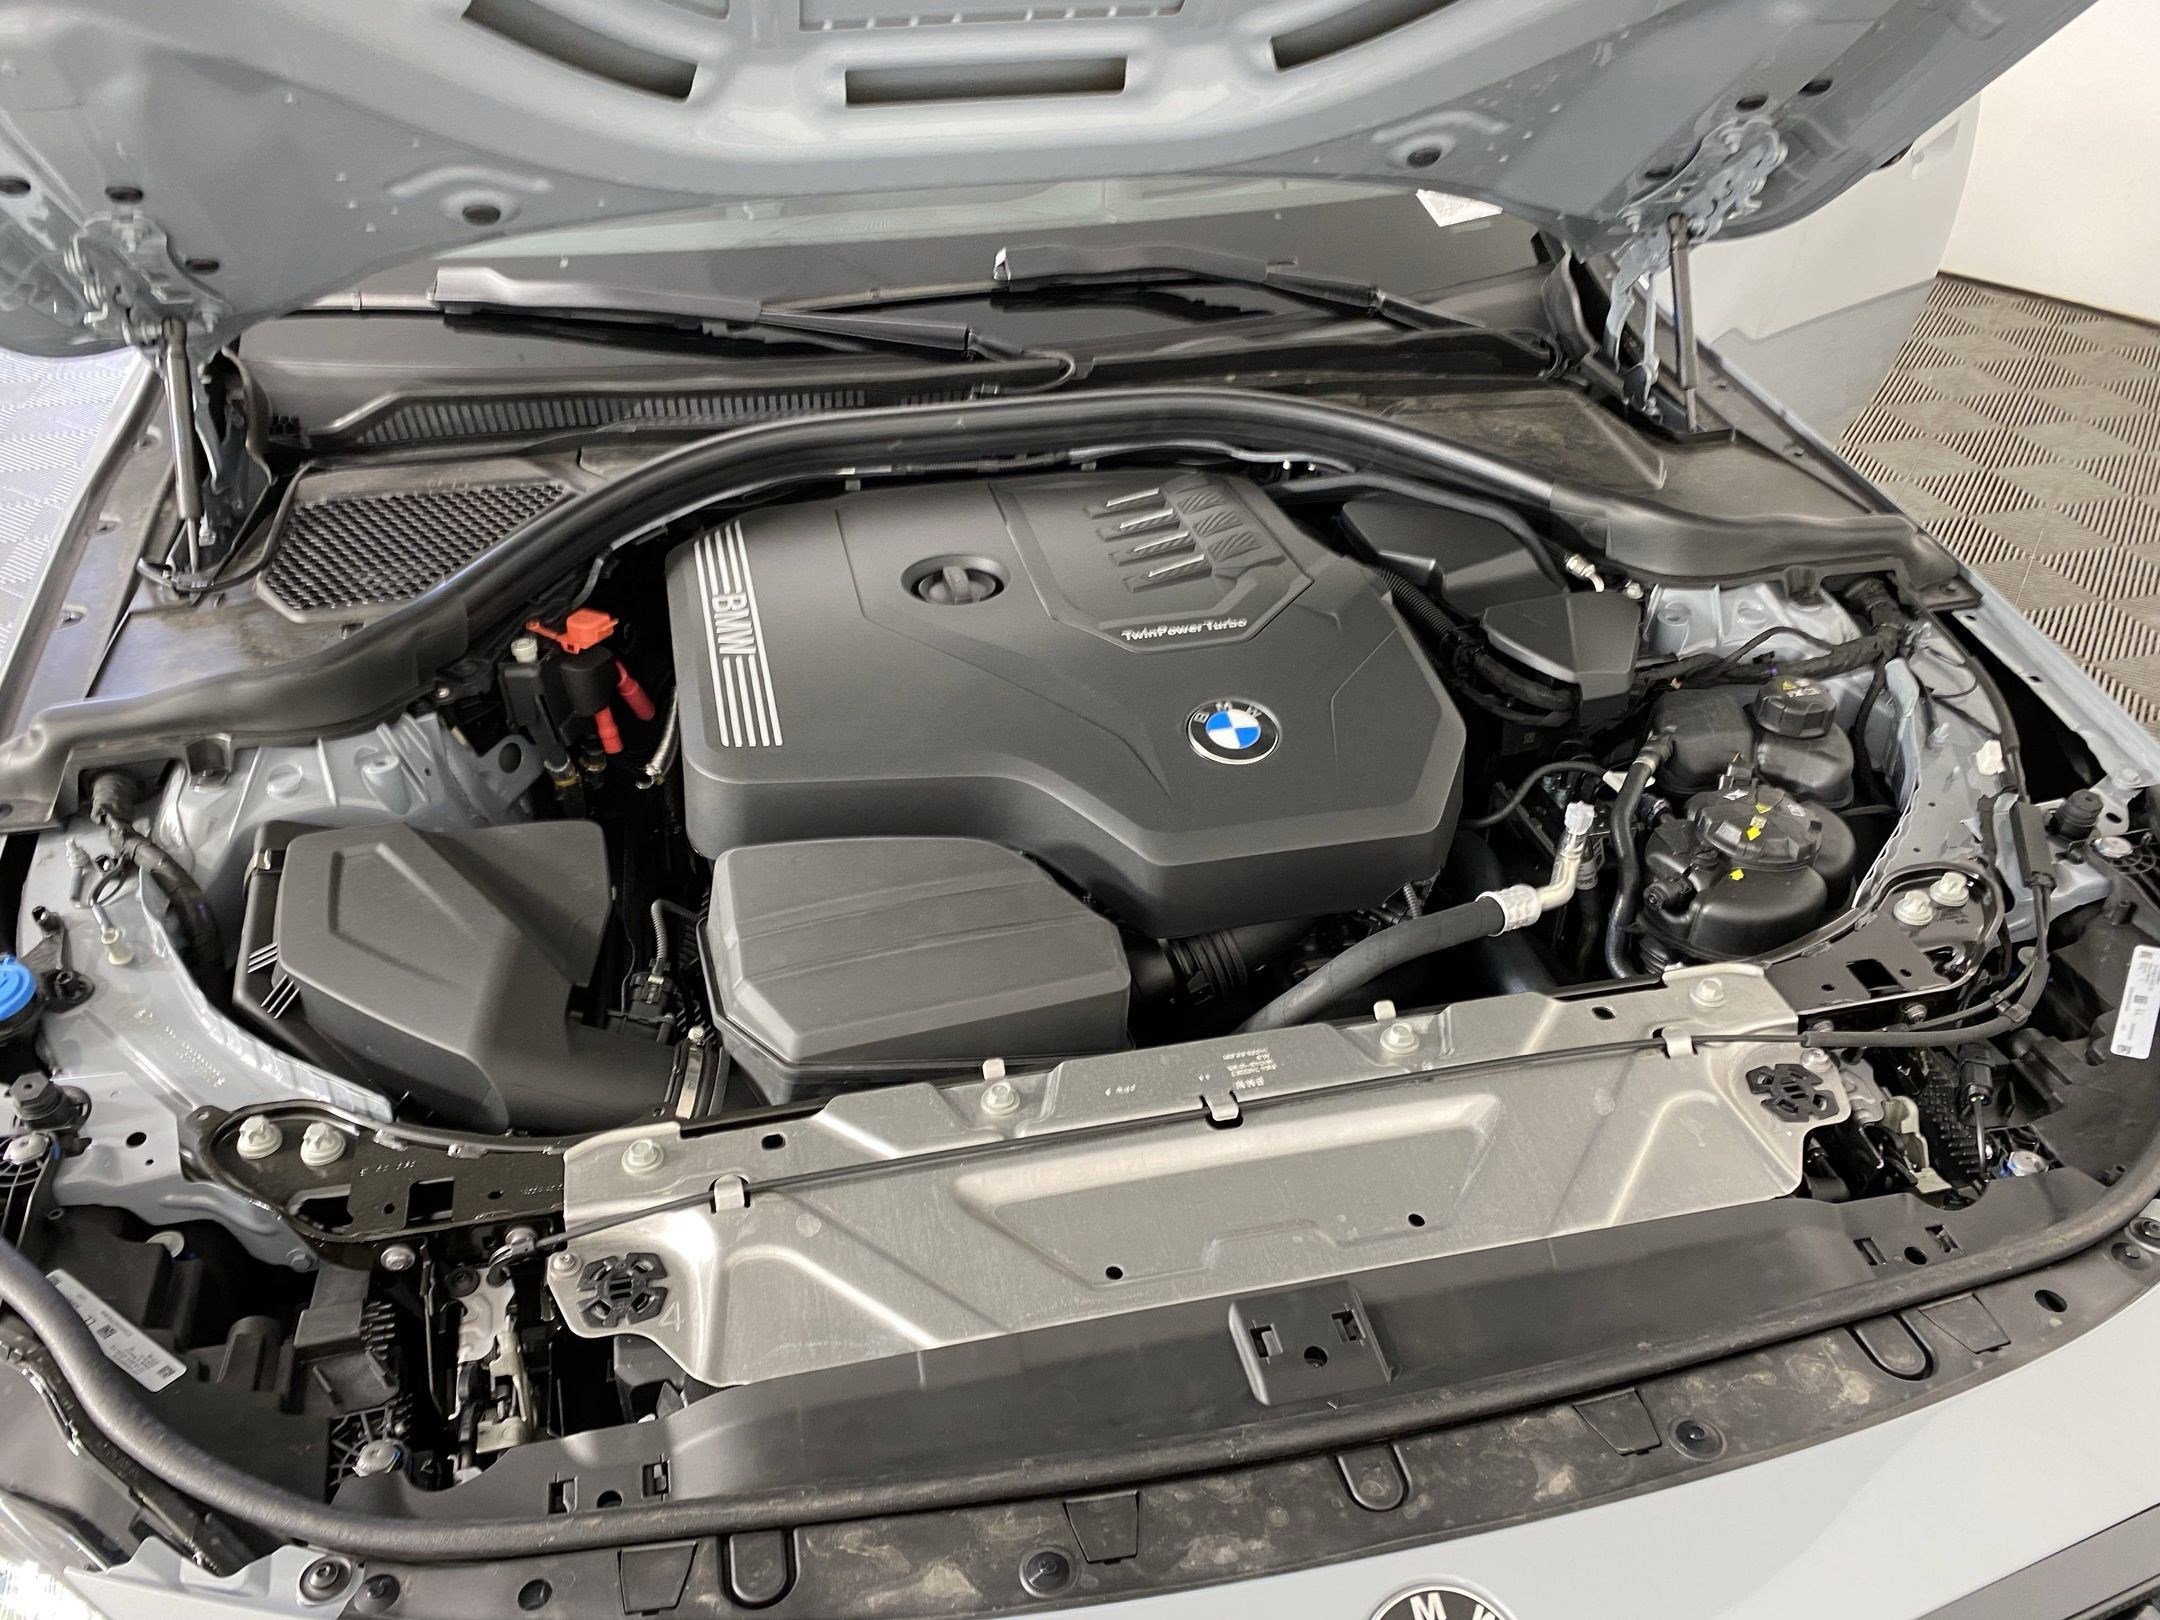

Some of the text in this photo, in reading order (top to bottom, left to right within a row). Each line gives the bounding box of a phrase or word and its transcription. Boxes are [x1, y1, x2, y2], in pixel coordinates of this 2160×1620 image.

[712, 592, 756, 654] BMW
[1121, 618, 1248, 640] TwinPower Turbo
